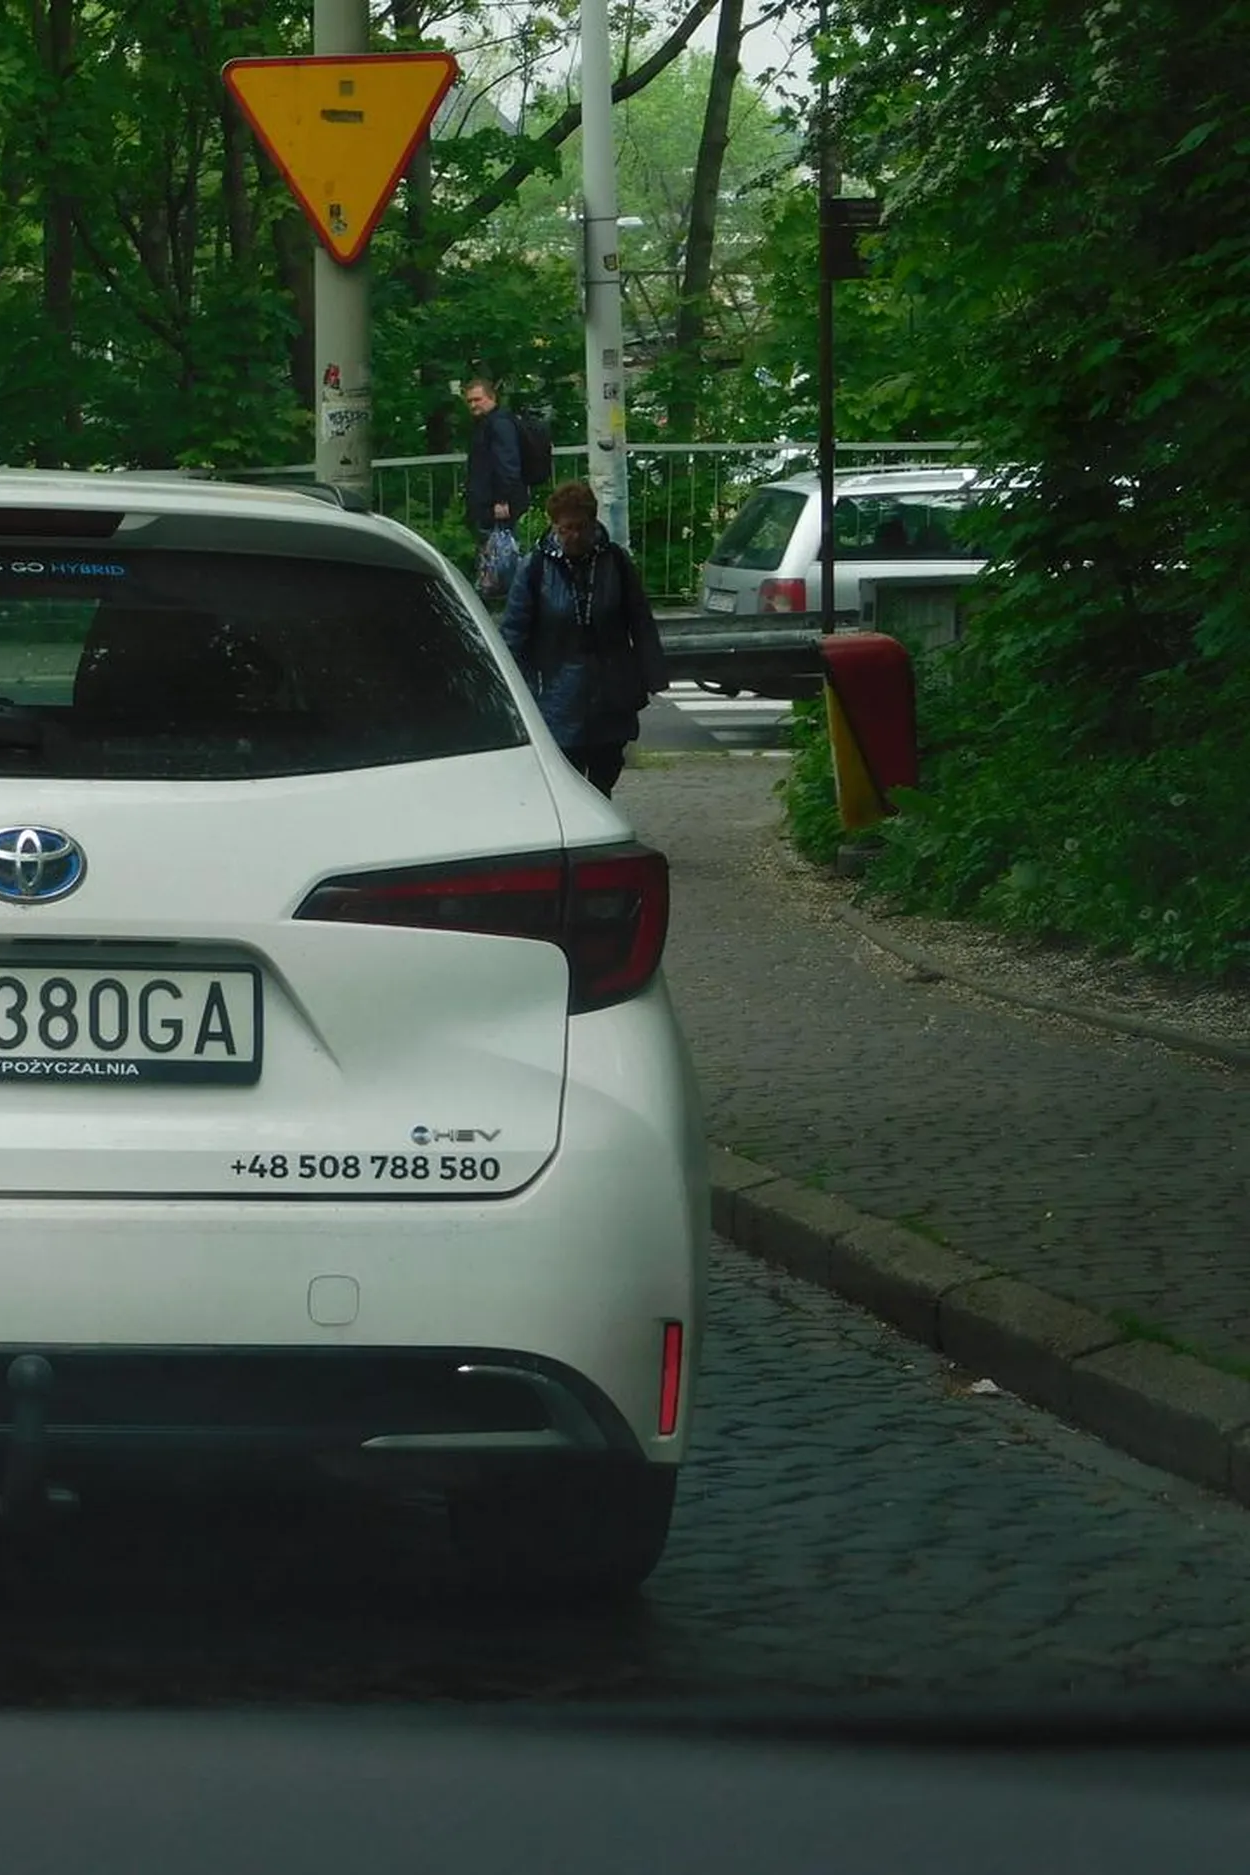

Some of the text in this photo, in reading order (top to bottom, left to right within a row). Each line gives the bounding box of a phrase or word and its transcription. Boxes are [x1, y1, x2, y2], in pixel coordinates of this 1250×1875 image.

[11, 562, 45, 573] GO
[51, 563, 125, 577] HYBRID
[434, 1129, 501, 1143] HEV
[231, 1154, 500, 1180] +48 508 788 580
